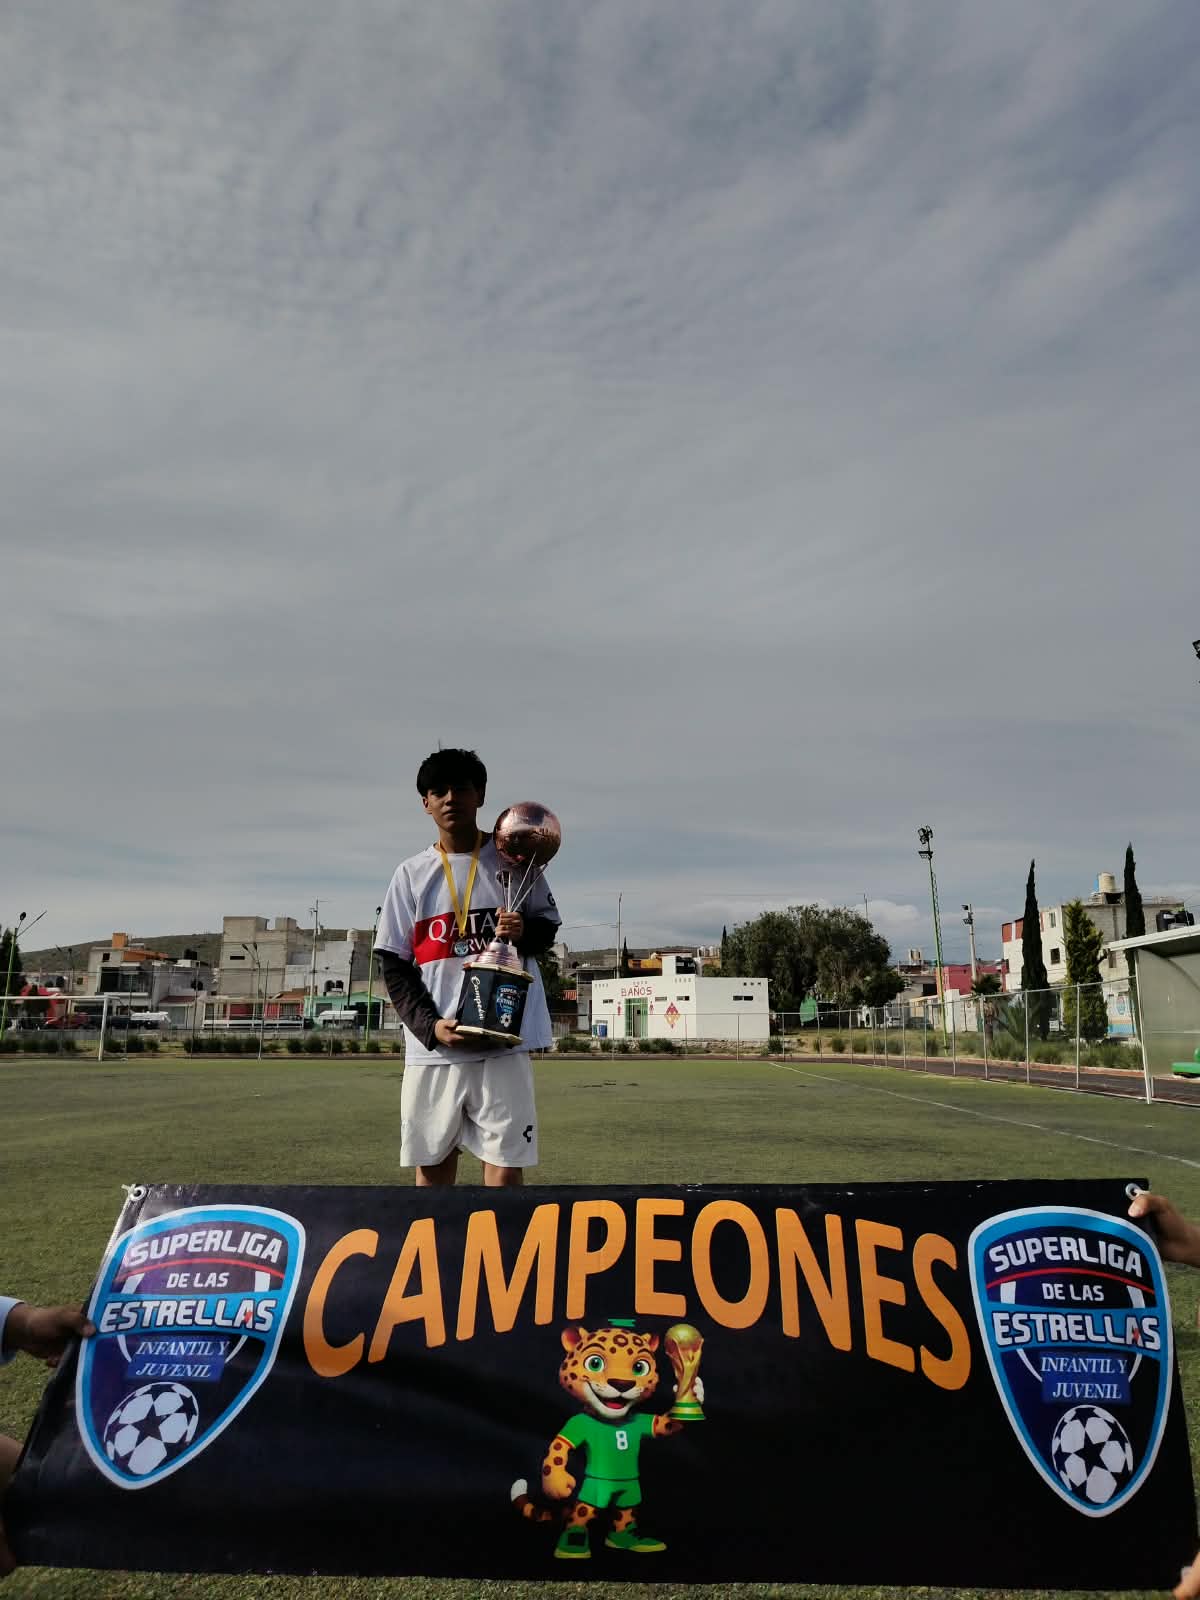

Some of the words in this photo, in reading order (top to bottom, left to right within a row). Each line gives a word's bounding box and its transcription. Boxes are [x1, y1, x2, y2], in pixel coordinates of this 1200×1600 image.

[621, 985, 653, 997] BAÑOS
[126, 1229, 283, 1266] SUPERLIGA
[988, 1236, 1143, 1277] SUPERLIGA
[166, 1274, 190, 1289] DE
[193, 1272, 228, 1288] LAS
[302, 1198, 972, 1391] CAMPEONES
[1042, 1283, 1064, 1300] DE
[1069, 1283, 1105, 1302] LAS
[99, 1299, 277, 1333] ESTRELLAS
[992, 1311, 1161, 1351] ESTRELLAS
[135, 1341, 216, 1355] INFANTIL
[217, 1341, 229, 1355] Y
[135, 1363, 210, 1378] JUVENIL
[1039, 1356, 1115, 1374] INFANTIL
[1117, 1359, 1128, 1374] Y
[1052, 1382, 1122, 1400] JUVENIL
[616, 1430, 628, 1450] 8
